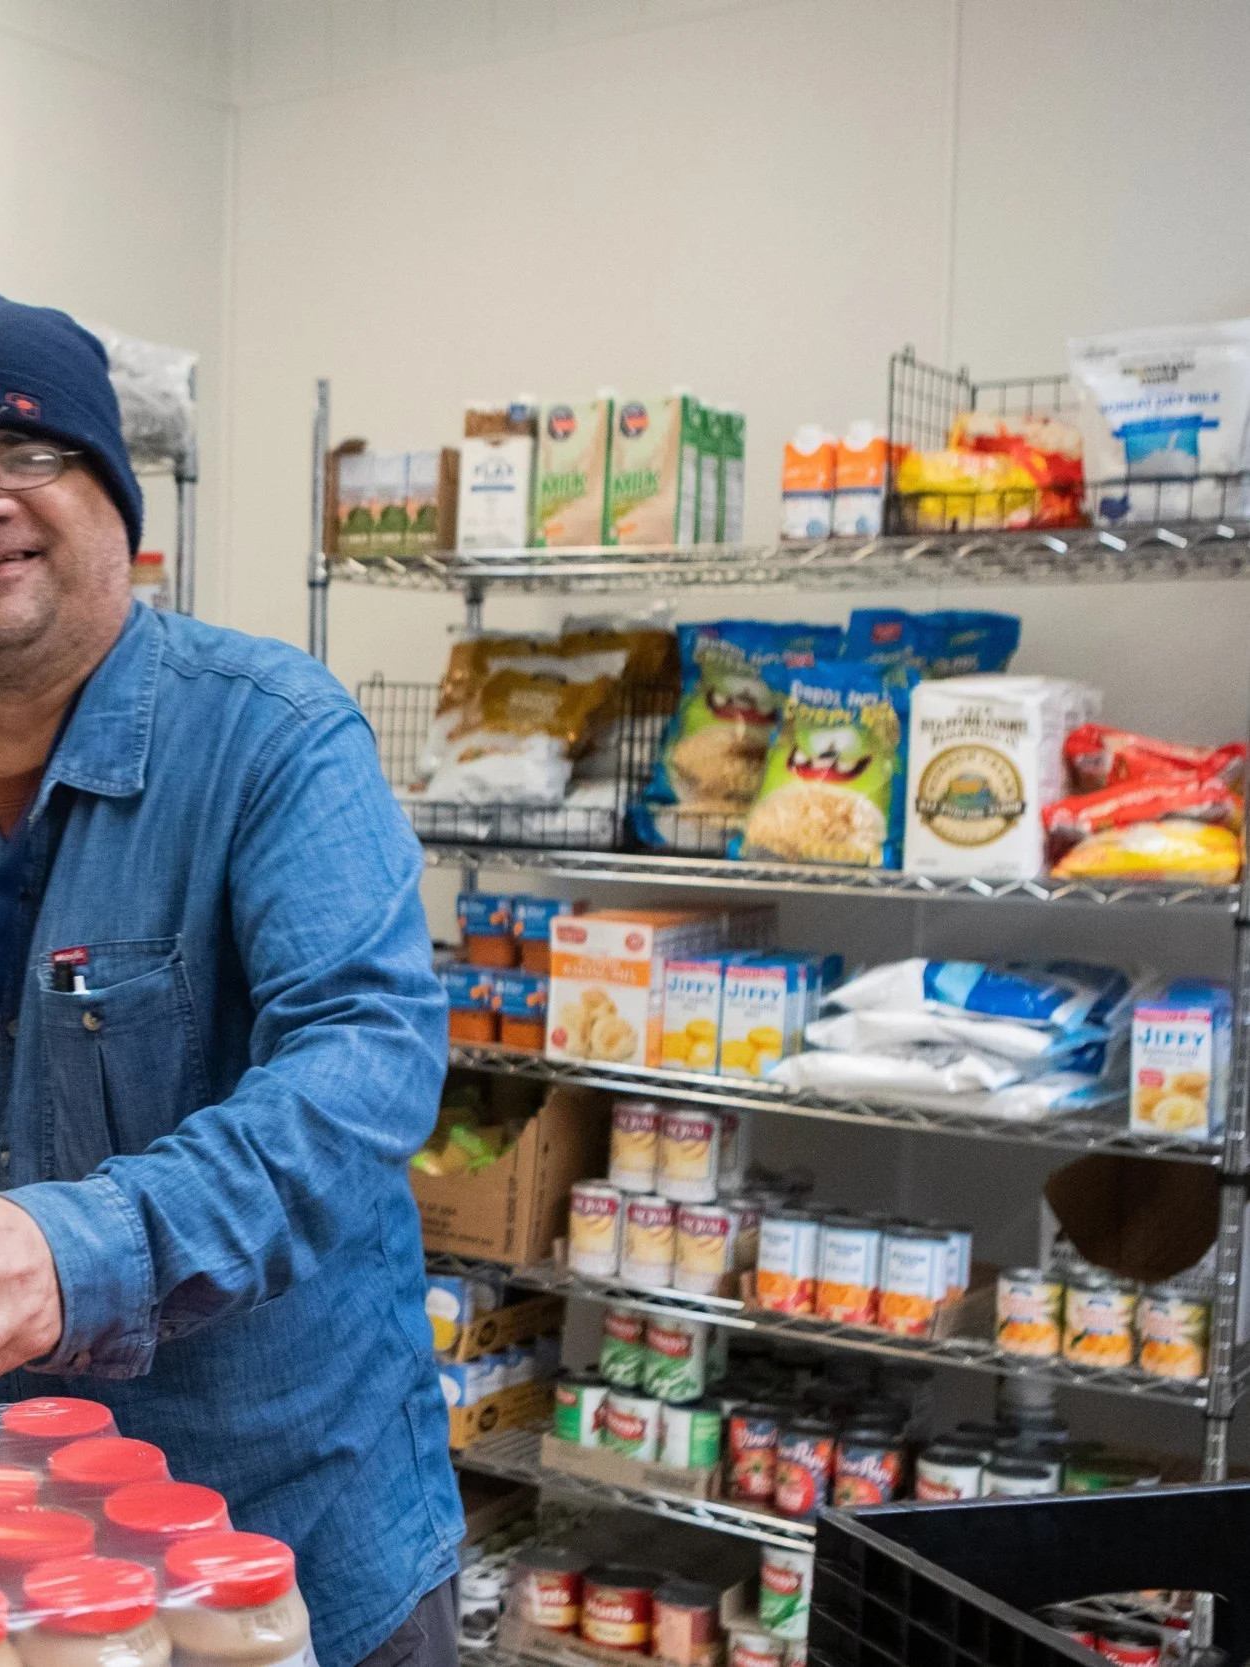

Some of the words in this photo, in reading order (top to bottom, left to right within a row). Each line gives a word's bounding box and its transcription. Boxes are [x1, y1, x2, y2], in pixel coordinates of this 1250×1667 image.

[668, 976, 716, 994] JIFFY
[727, 980, 780, 1002] JIFFY
[1135, 1027, 1204, 1048] JIFFY
